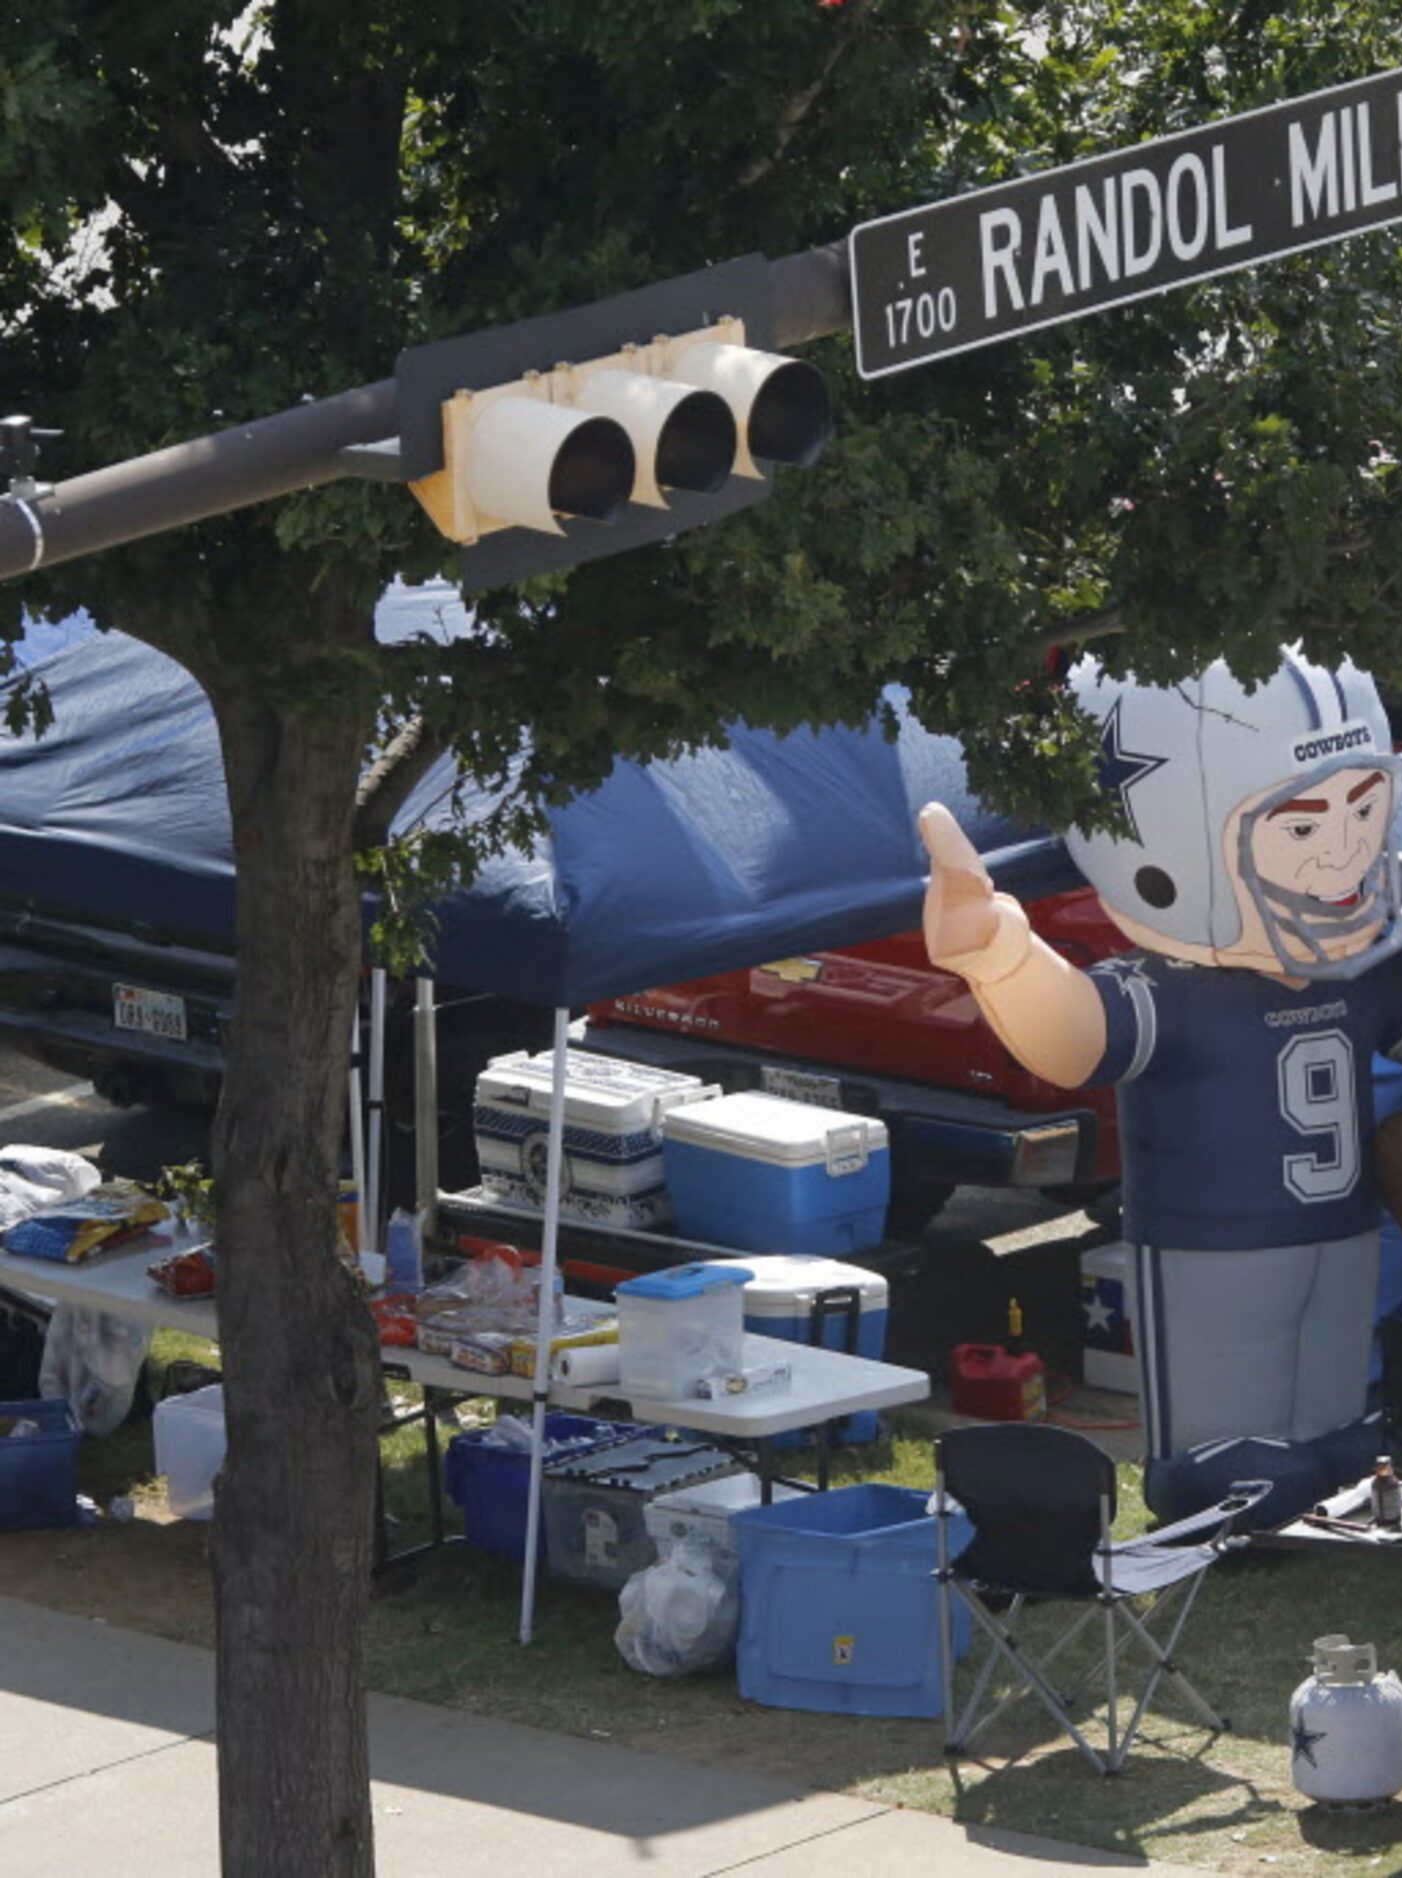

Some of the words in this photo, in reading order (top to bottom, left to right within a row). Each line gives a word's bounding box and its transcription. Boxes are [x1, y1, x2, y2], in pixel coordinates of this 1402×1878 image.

[908, 231, 927, 279] E
[979, 145, 1252, 319] RANDOL
[885, 287, 957, 349] 1700
[1293, 726, 1372, 762] COWBOYS
[1277, 1028, 1361, 1205] 9
